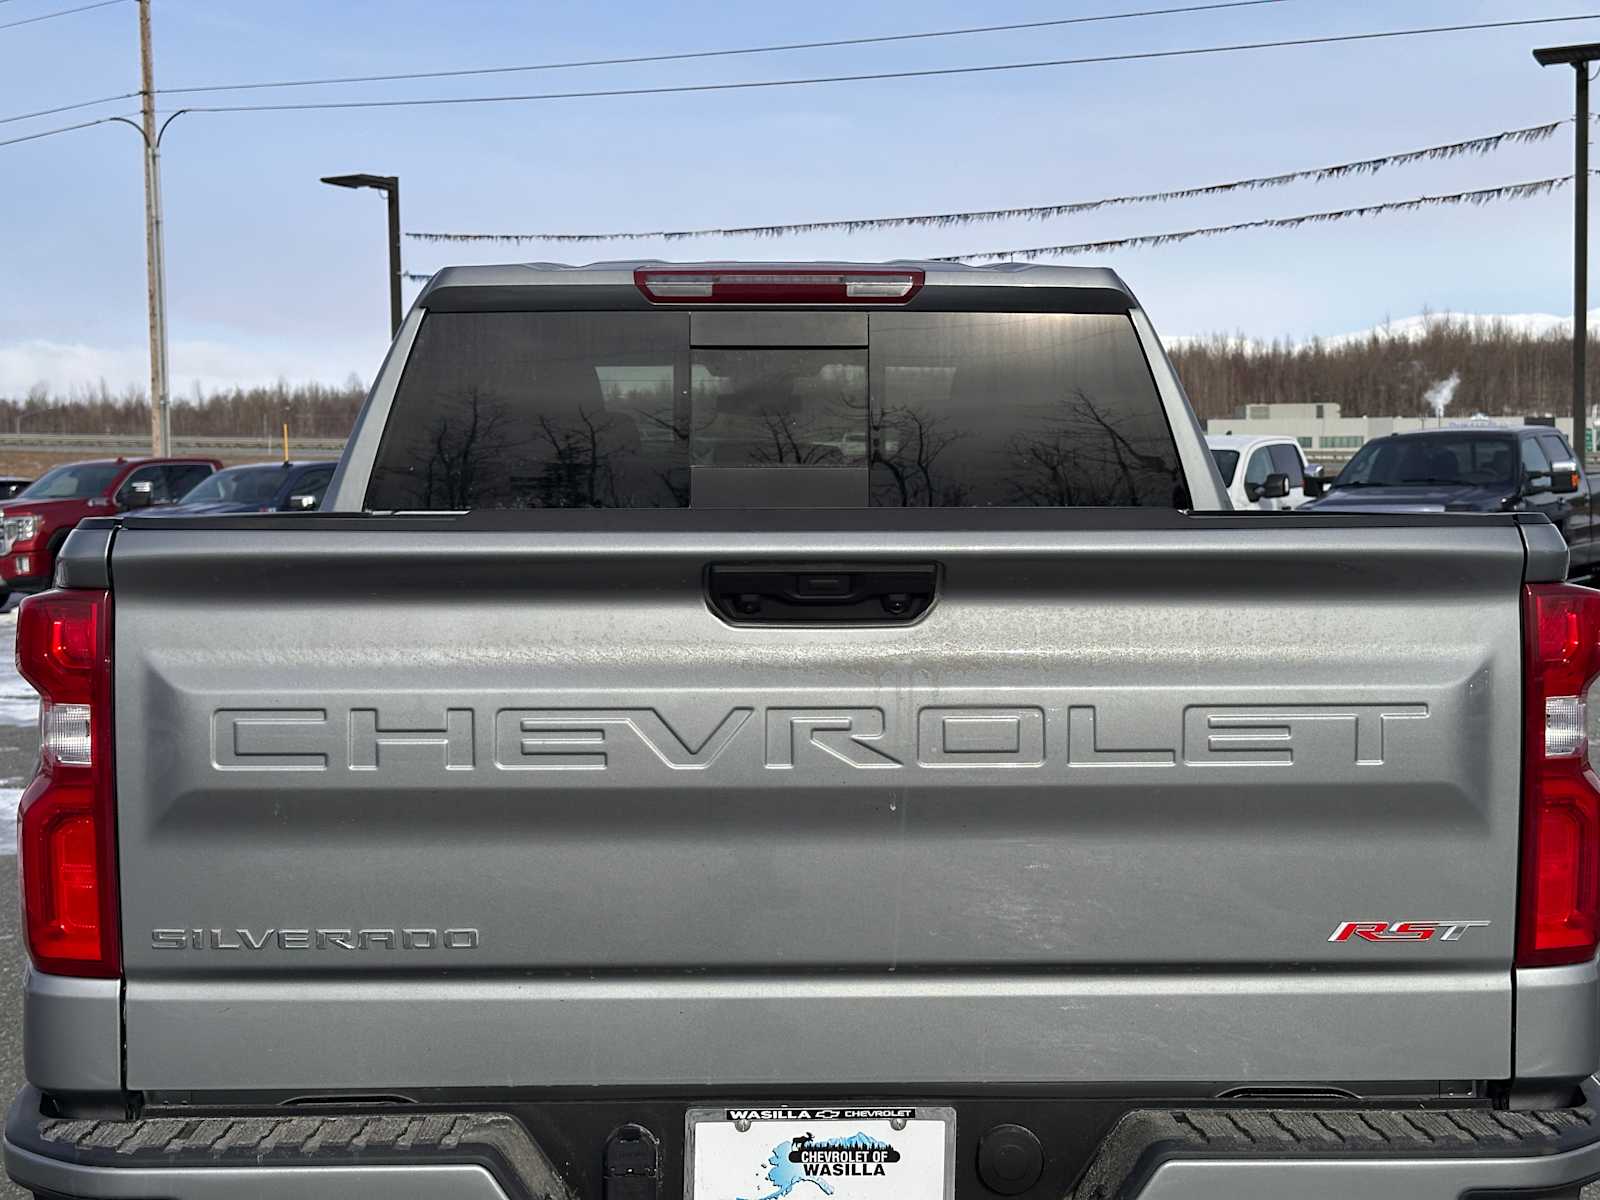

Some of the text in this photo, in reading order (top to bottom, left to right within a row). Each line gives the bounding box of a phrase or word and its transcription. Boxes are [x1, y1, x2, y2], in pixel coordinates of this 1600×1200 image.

[210, 703, 1429, 771] CHEVROLET
[152, 928, 480, 950] SILVERADO
[1327, 920, 1492, 942] RST
[730, 1110, 911, 1119] WASILLA CHEVROLET
[801, 1151, 888, 1163] CHEVROLET OF
[803, 1163, 886, 1176] WASILLA
